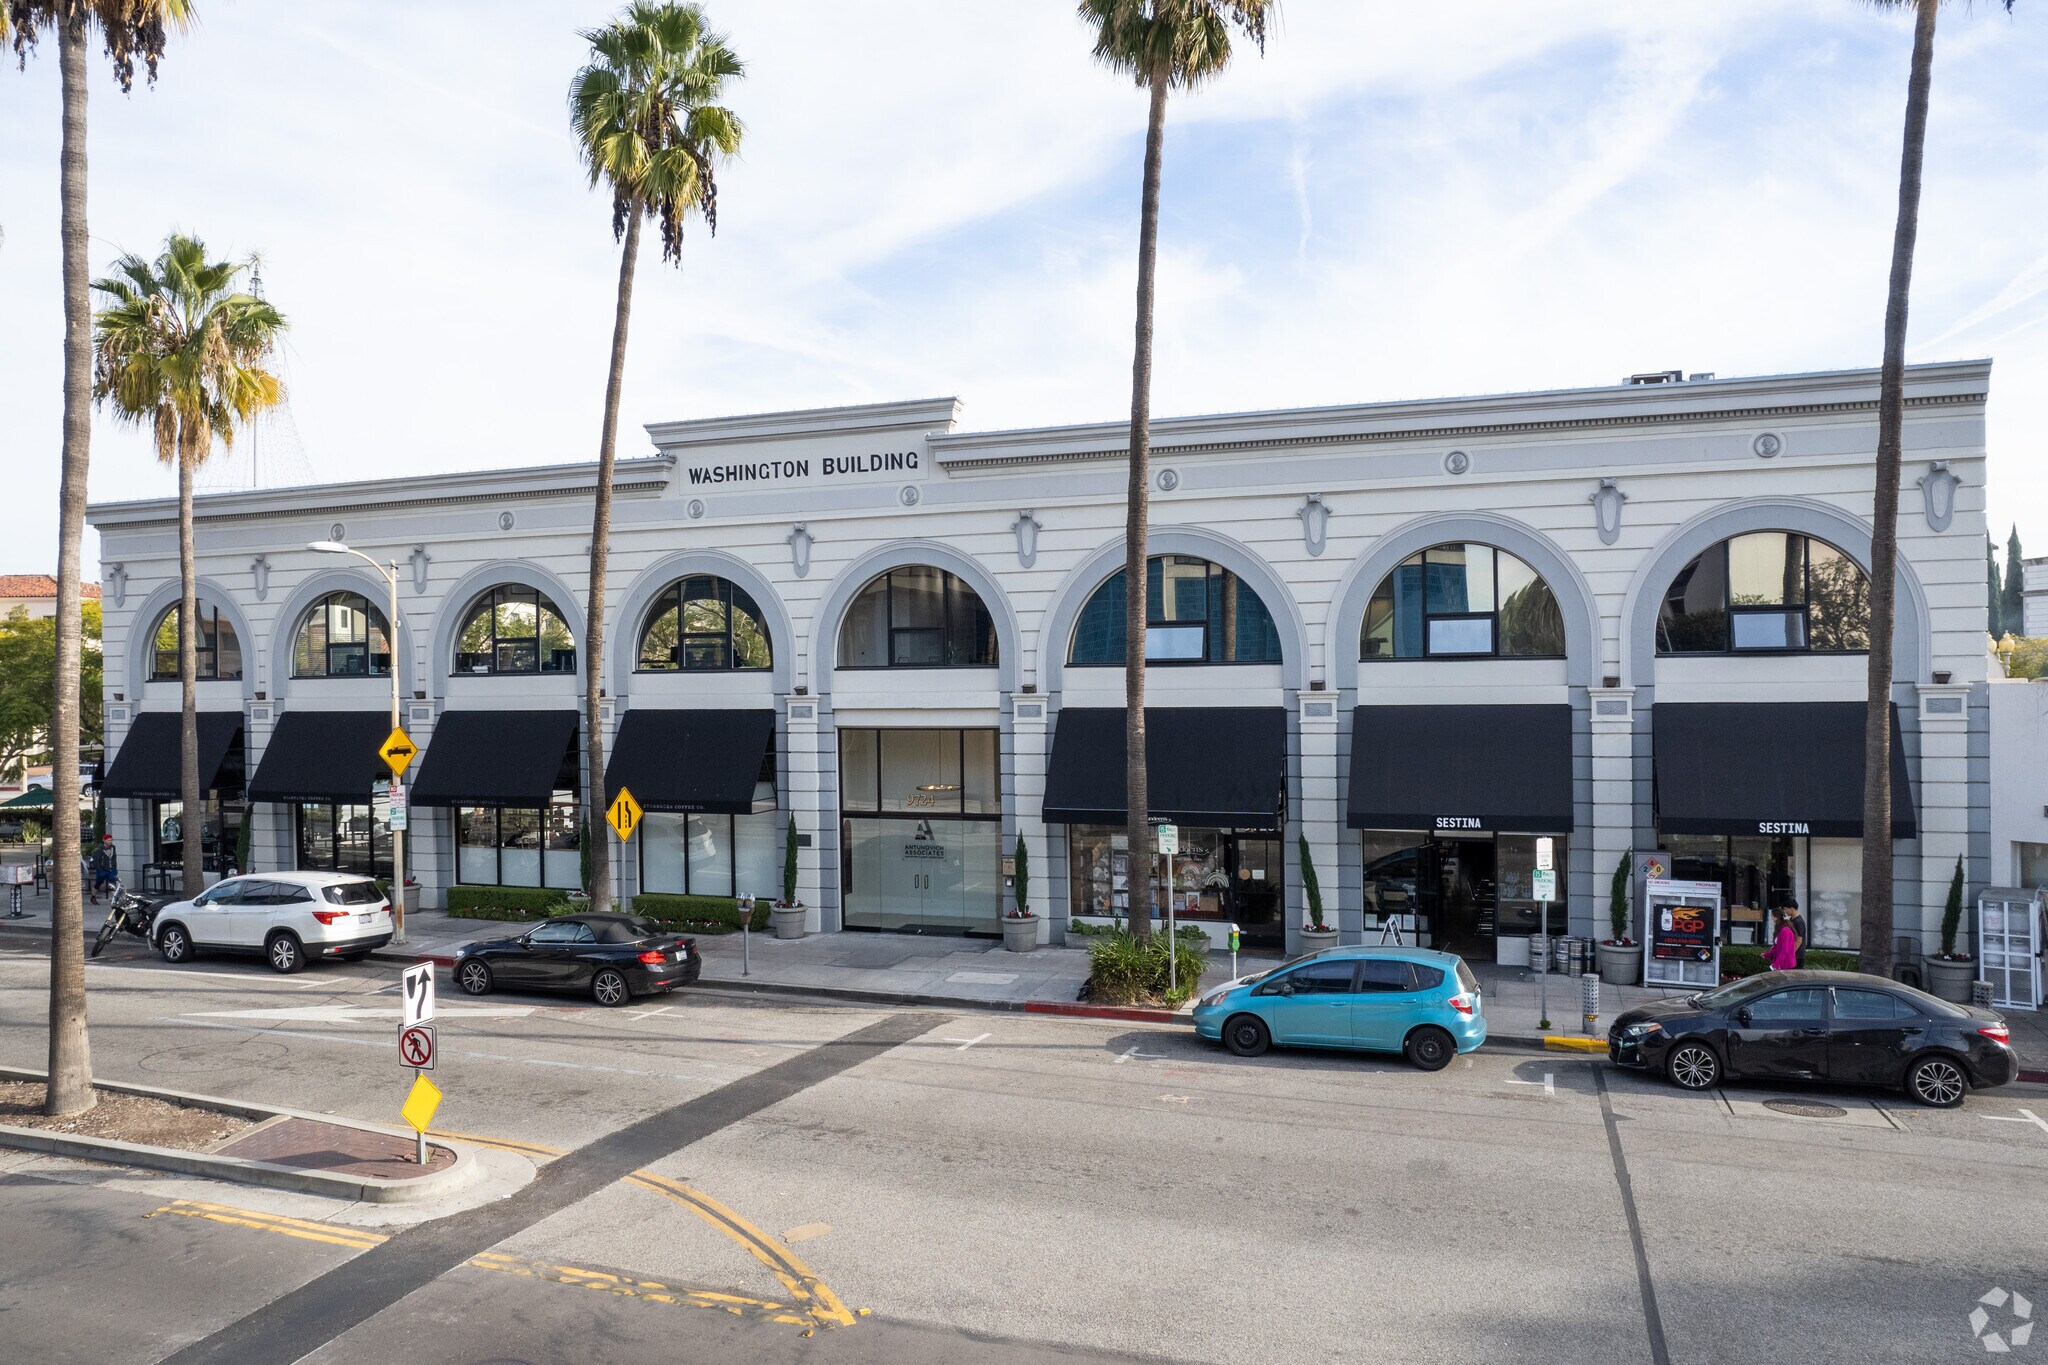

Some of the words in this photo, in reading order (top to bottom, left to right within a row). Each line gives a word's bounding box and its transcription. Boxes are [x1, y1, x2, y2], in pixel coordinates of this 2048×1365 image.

[688, 459, 809, 485] WASHINGTON
[822, 451, 919, 476] BUILDING
[906, 794, 936, 807] 9724
[1436, 817, 1481, 828] SESTINA
[1759, 822, 1809, 834] SESTINA
[1672, 919, 1705, 933] PGP
